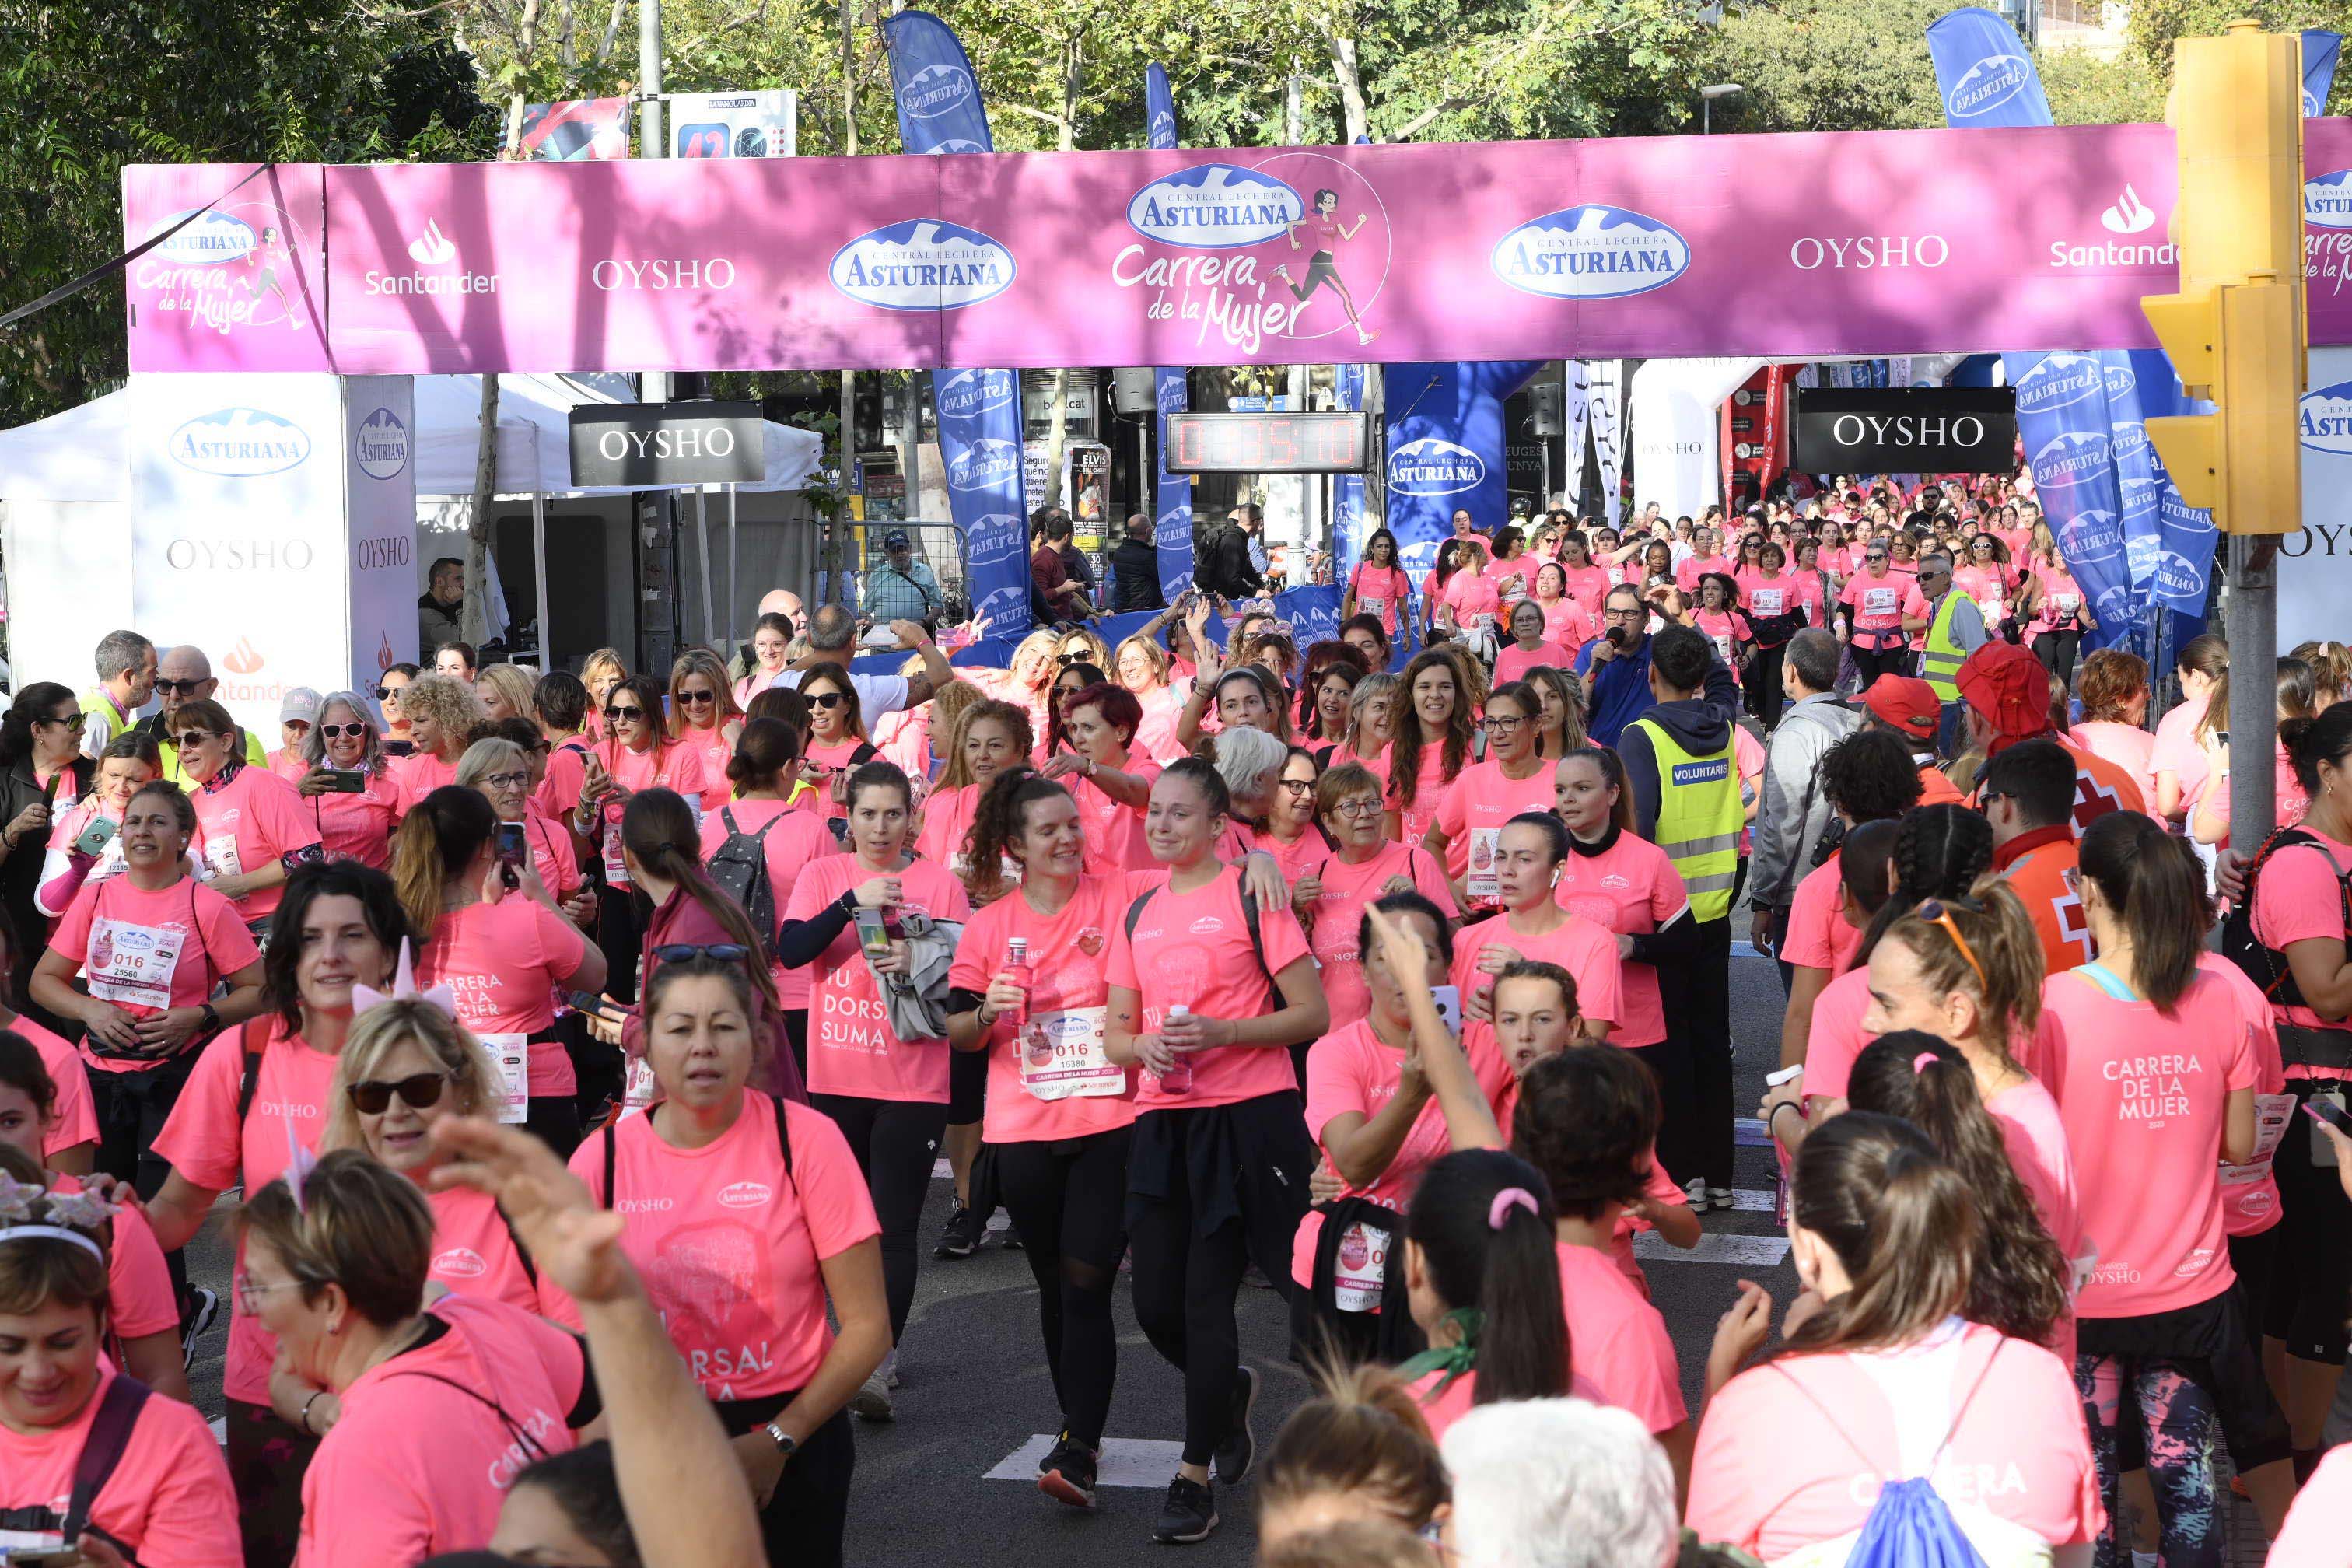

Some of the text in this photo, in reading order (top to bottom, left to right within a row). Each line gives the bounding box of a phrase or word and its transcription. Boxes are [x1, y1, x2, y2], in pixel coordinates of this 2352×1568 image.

[1167, 192, 1286, 201] CENTRAL LECHERA
[1140, 196, 1290, 227] ASTURIANA
[1538, 236, 1668, 247] CENTRAL LECHERA
[1790, 234, 1948, 270] OYSHO
[873, 250, 996, 260] CENTRAL LECHERA
[1111, 243, 1258, 289] Carrera
[1508, 241, 1675, 275] ASTURIANA
[136, 261, 228, 289] Carrera
[592, 258, 735, 291] OYSHO
[844, 254, 1002, 287] ASTURIANA
[364, 271, 501, 295] Santander
[159, 286, 261, 334] de la Mujer
[1147, 282, 1312, 355] de la Mujer
[1833, 415, 1983, 446] OYSHO
[180, 433, 300, 459] ASTURIANA
[360, 435, 405, 461] ASTURIANA
[599, 427, 735, 460] OYSHO
[1083, 455, 1105, 464] ELVIS
[1025, 468, 1037, 477] que
[1025, 477, 1049, 487] quiere
[1391, 462, 1478, 483] ASTURIANA
[2278, 524, 2352, 557] OY
[166, 539, 313, 570] OYSHO
[358, 535, 409, 570] OYSHO
[1090, 555, 1101, 564] 30
[1674, 764, 1727, 780] VOLUNTARIS
[114, 953, 144, 968] 016
[1003, 950, 1045, 962] OHO
[827, 968, 850, 987] TU
[136, 992, 164, 1002] Santander
[459, 1004, 500, 1017] UJER
[821, 1021, 886, 1047] SUMA
[1052, 1024, 1088, 1034] ASTURIANA
[1055, 1044, 1088, 1056] 016
[1036, 1072, 1062, 1081] CARRERA
[2102, 1054, 2202, 1080] CARRERA
[2123, 1077, 2184, 1099] DE LA
[2119, 1097, 2190, 1120] MUJER
[618, 1198, 673, 1213] OYSHO
[1344, 1280, 1374, 1290] CARRERA
[1341, 1294, 1374, 1304] OYSHO
[691, 1341, 774, 1380] RSAL
